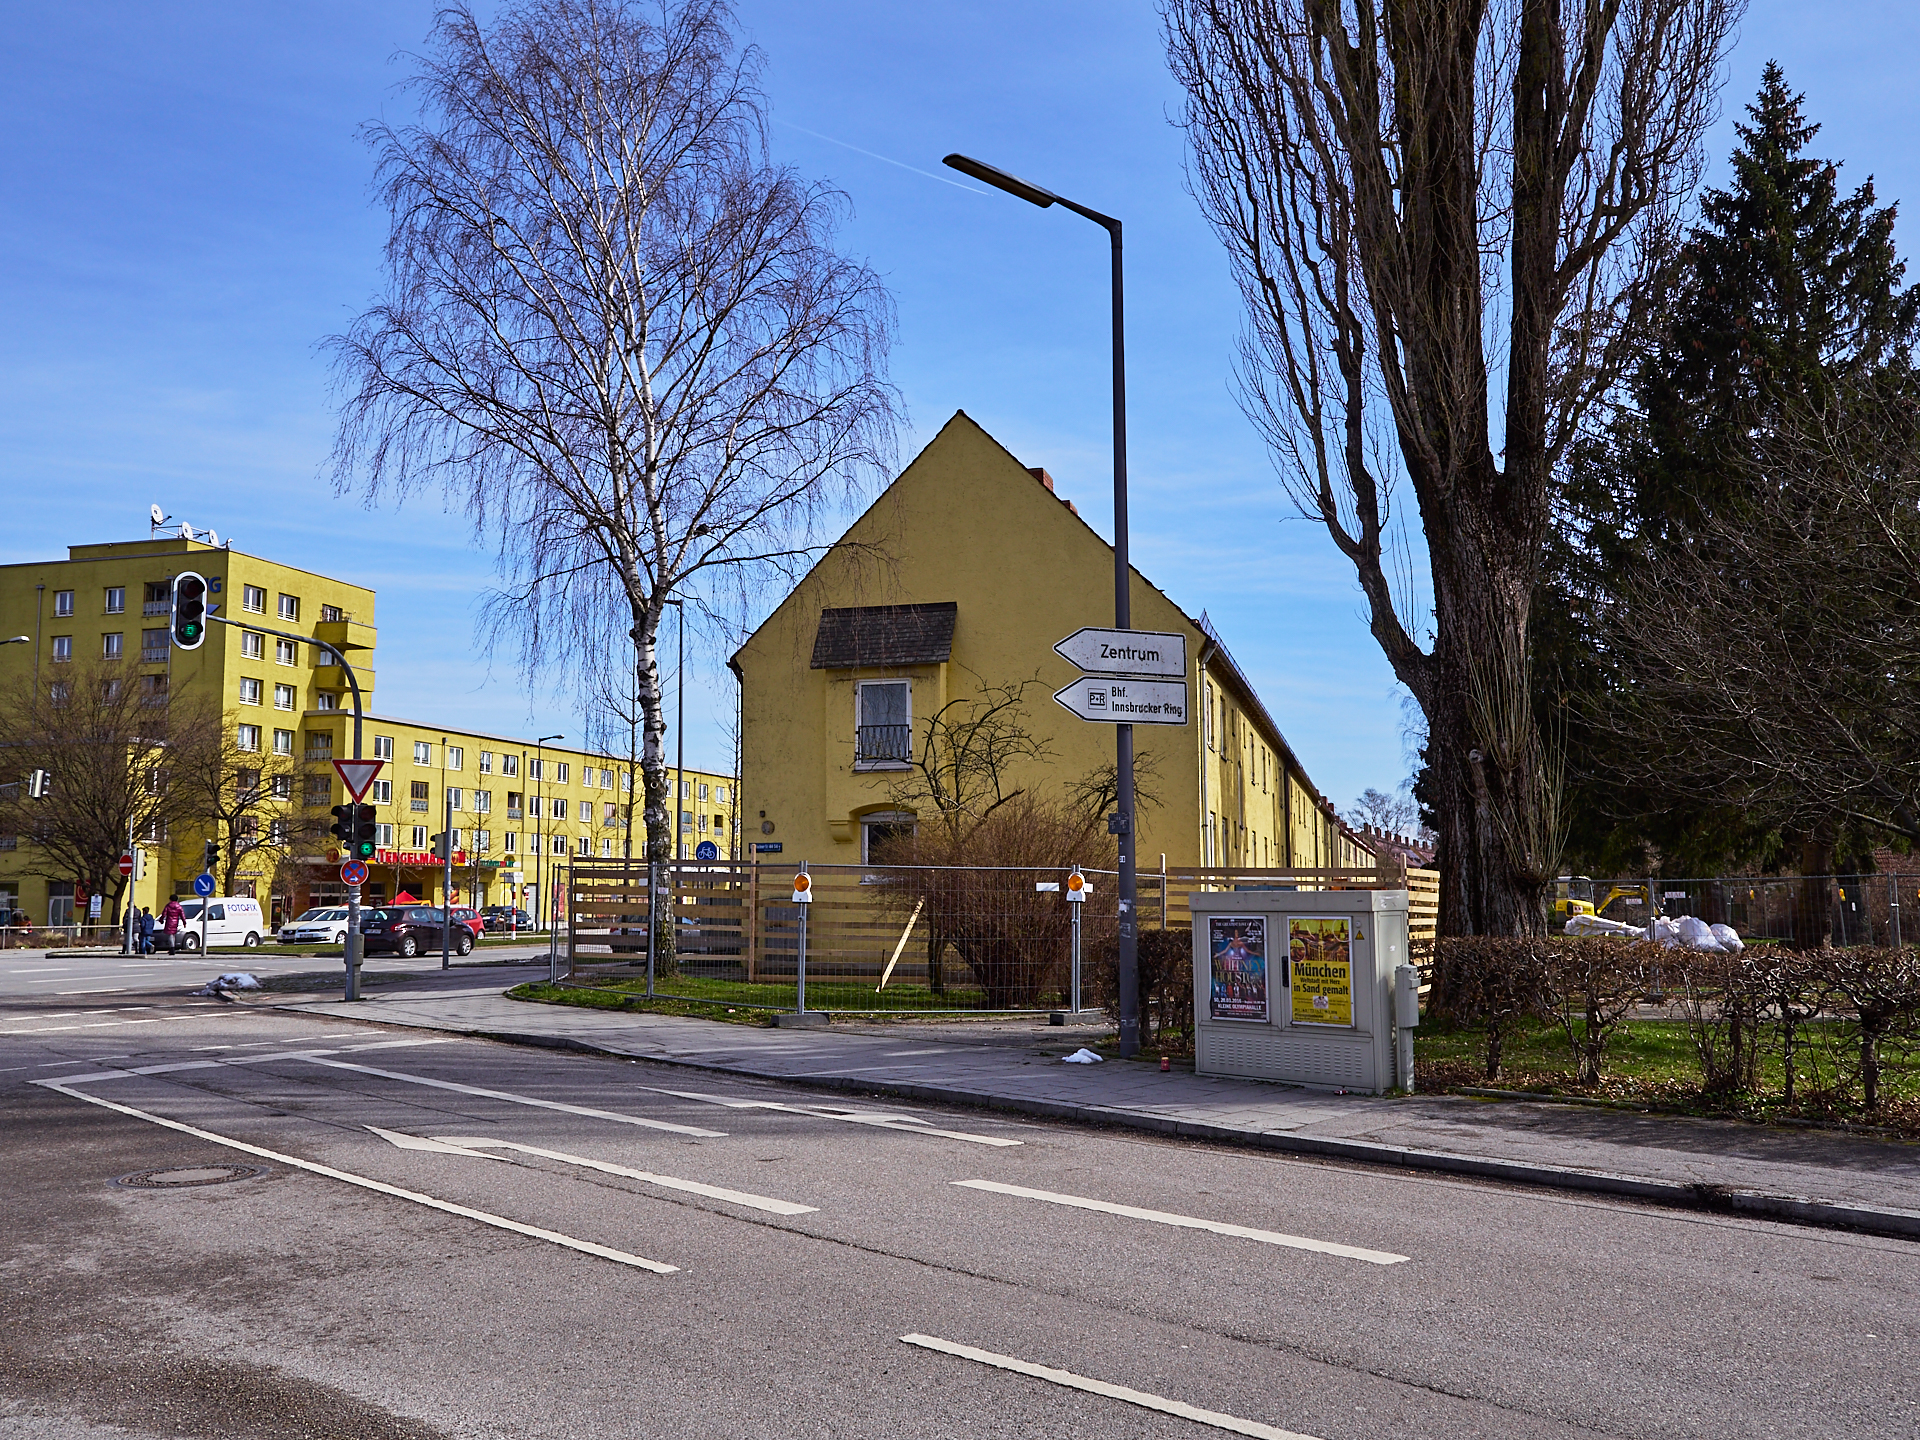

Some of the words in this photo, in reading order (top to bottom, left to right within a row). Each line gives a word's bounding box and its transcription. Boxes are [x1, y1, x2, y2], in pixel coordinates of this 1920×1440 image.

[1100, 643, 1159, 661] Zentrum
[1111, 686, 1128, 698] Bhf.
[1111, 700, 1162, 715] Innsbrucker
[1163, 703, 1183, 717] Ring
[378, 849, 446, 865] TENGELMA
[1214, 959, 1262, 972] WHITNEY
[1294, 963, 1346, 978] München
[1215, 971, 1262, 984] HOUSTON
[1293, 982, 1301, 992] in
[1302, 983, 1320, 994] Sand
[1322, 985, 1349, 996] gemalt
